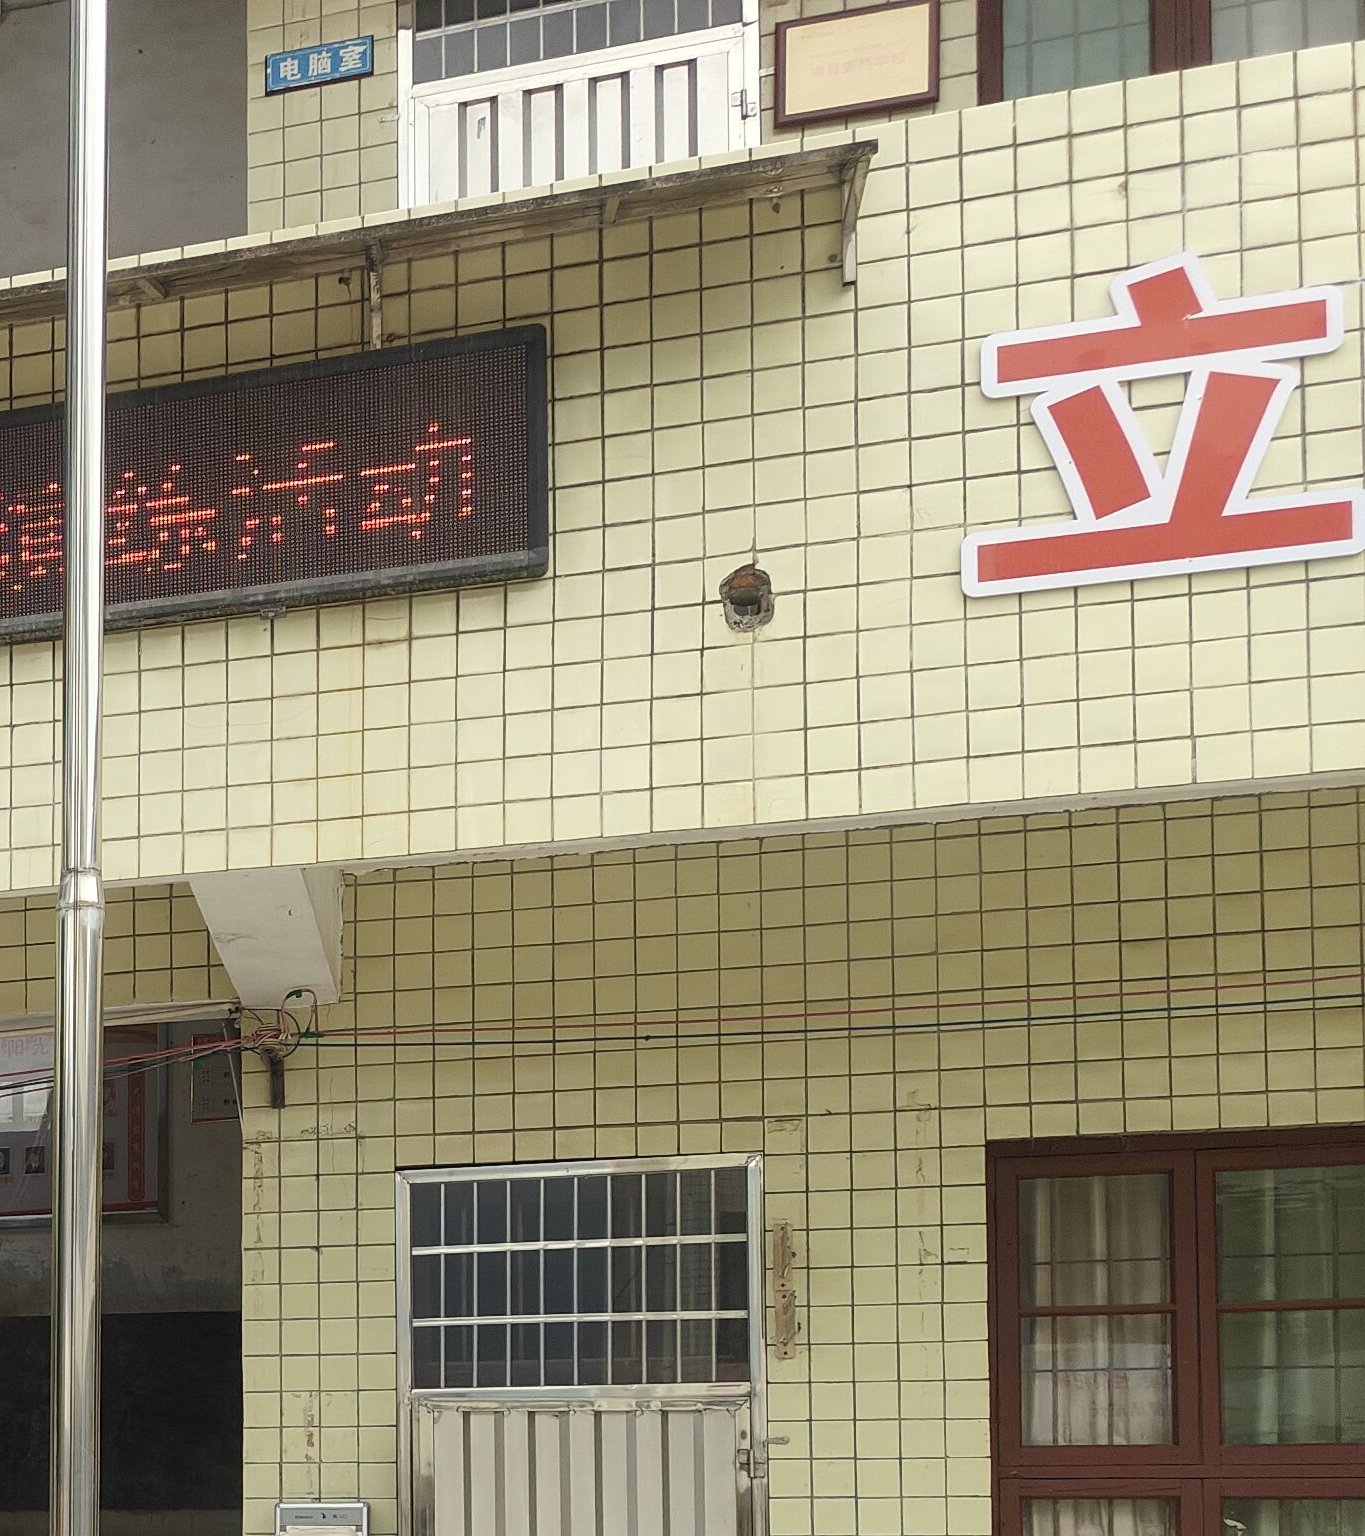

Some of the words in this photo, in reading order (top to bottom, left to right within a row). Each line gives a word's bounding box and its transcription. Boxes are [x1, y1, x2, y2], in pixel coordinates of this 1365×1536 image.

[279, 43, 367, 81] 电脑室
[971, 262, 1357, 590] 立
